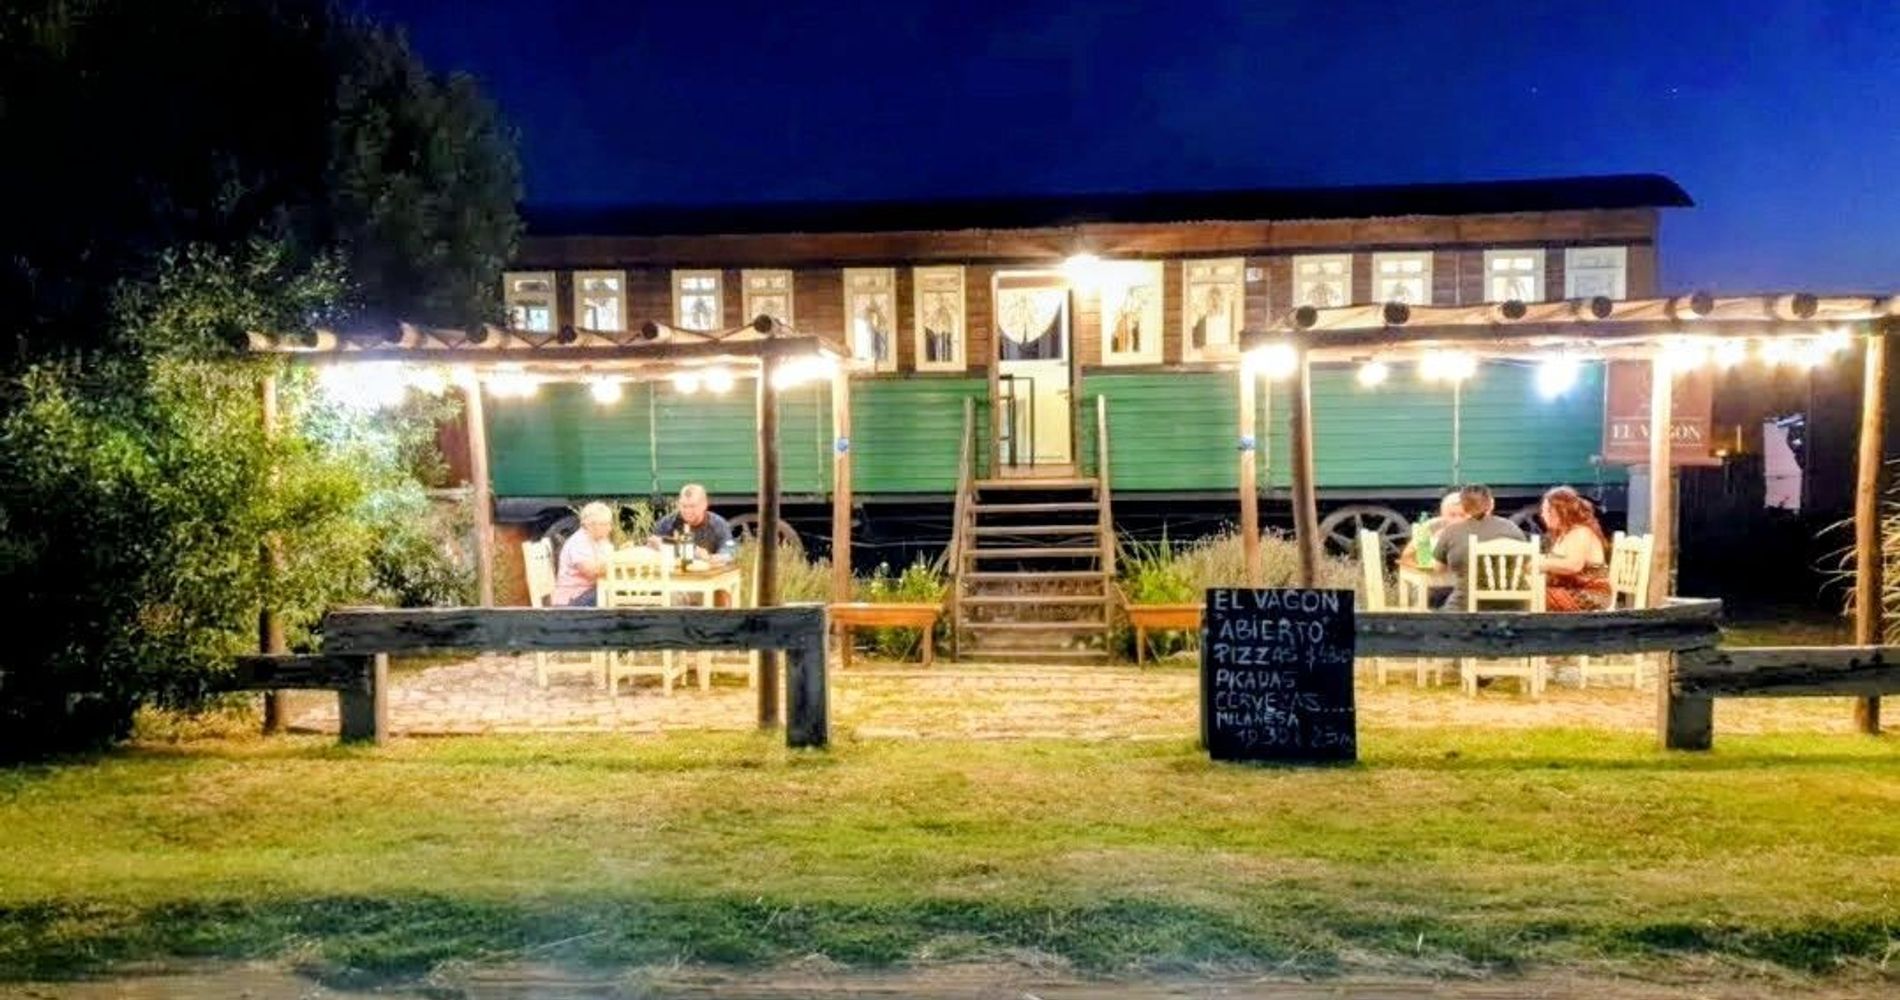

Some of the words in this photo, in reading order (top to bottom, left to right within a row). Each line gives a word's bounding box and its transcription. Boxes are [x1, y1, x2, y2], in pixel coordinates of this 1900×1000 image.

[1214, 590, 1244, 611] EL
[1254, 590, 1340, 613] VAGON
[1213, 643, 1299, 666] PIZZAS
[1216, 711, 1299, 730] MILANESA
